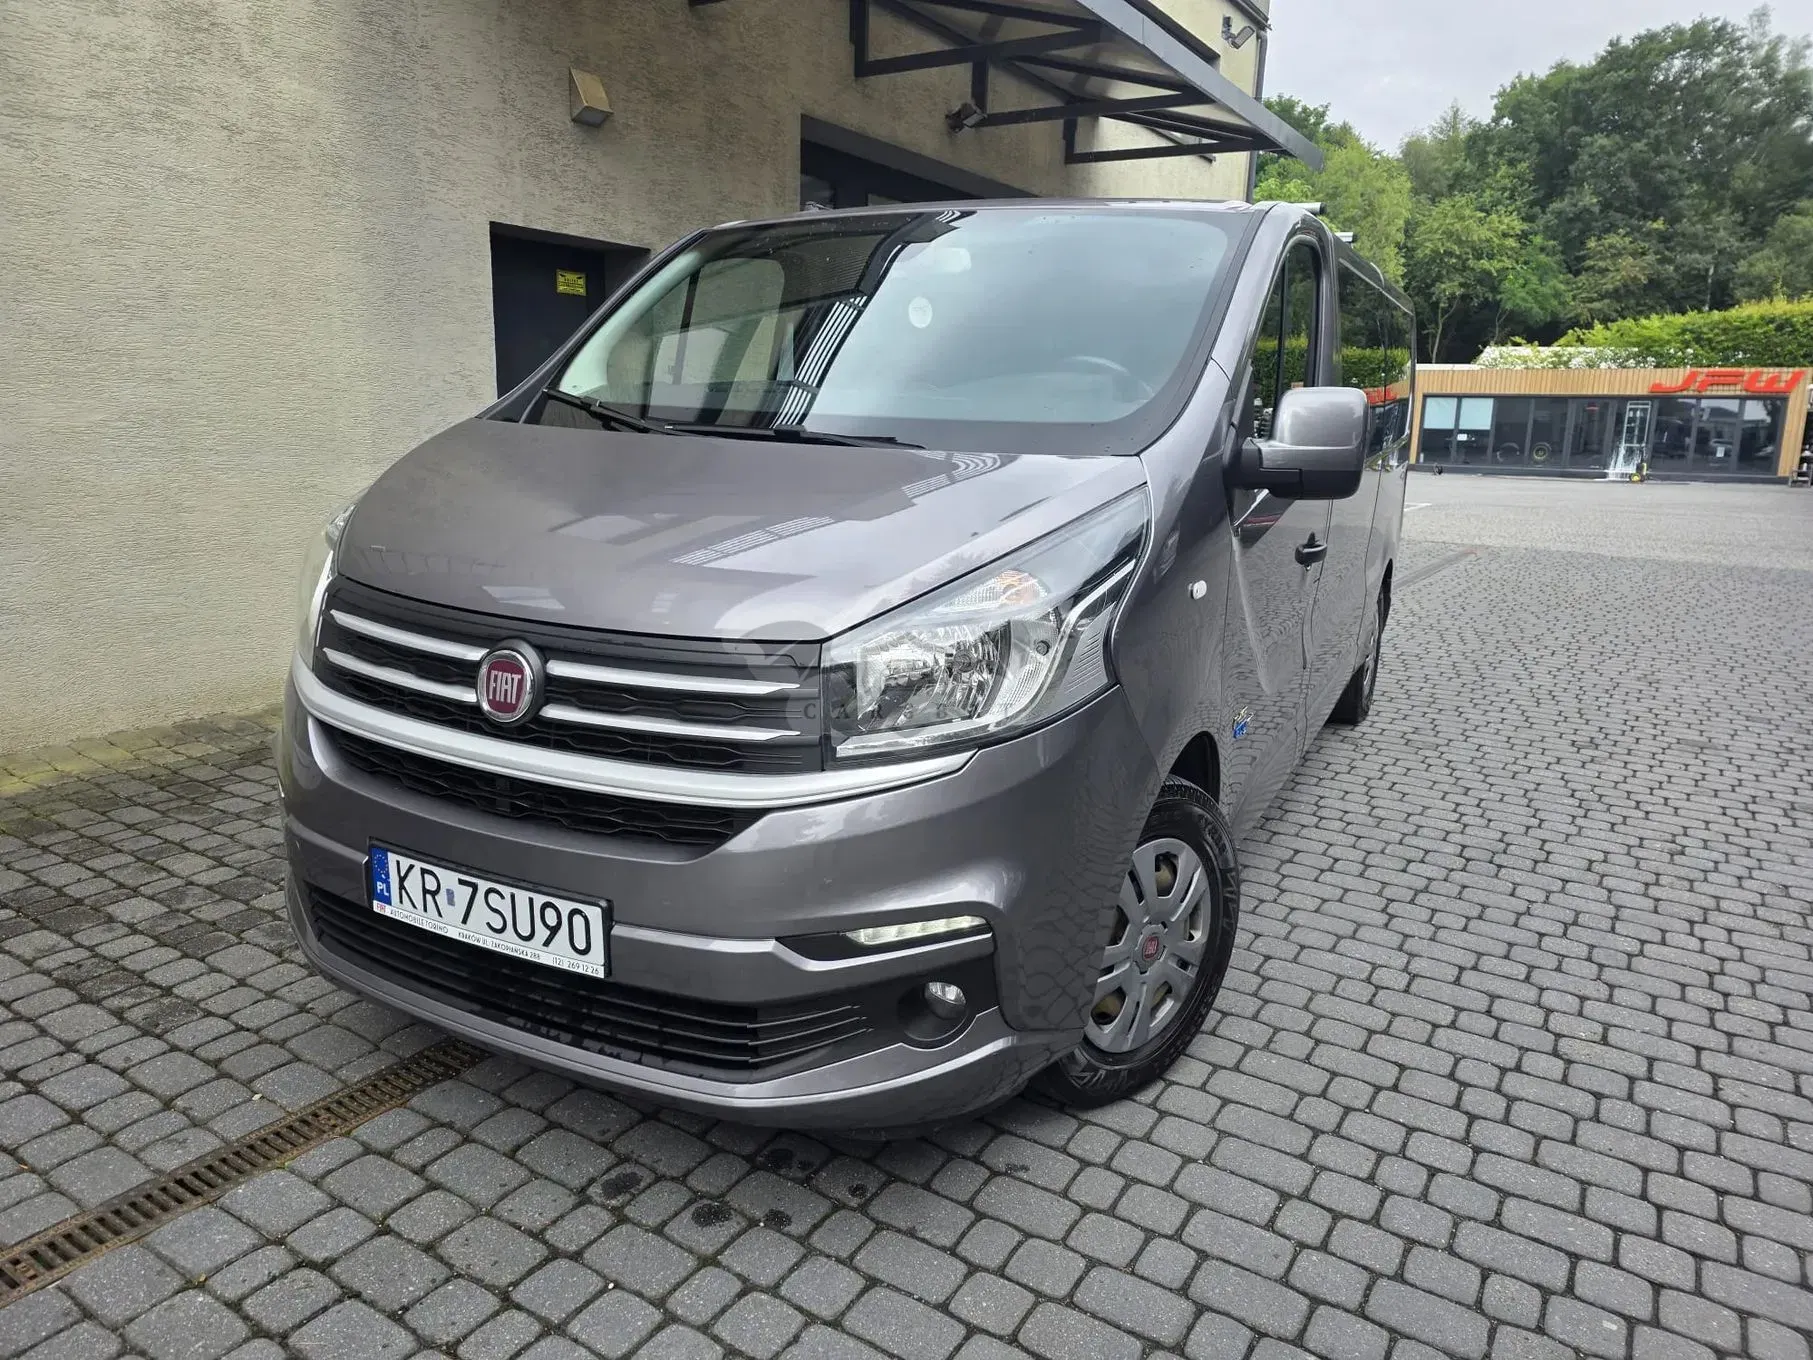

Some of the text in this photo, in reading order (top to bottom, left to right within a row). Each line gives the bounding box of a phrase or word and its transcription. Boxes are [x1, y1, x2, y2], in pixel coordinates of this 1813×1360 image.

[488, 669, 522, 705] FIAT
[376, 881, 390, 896] PL
[395, 859, 592, 956] KR 7SU90
[567, 960, 580, 970] 269
